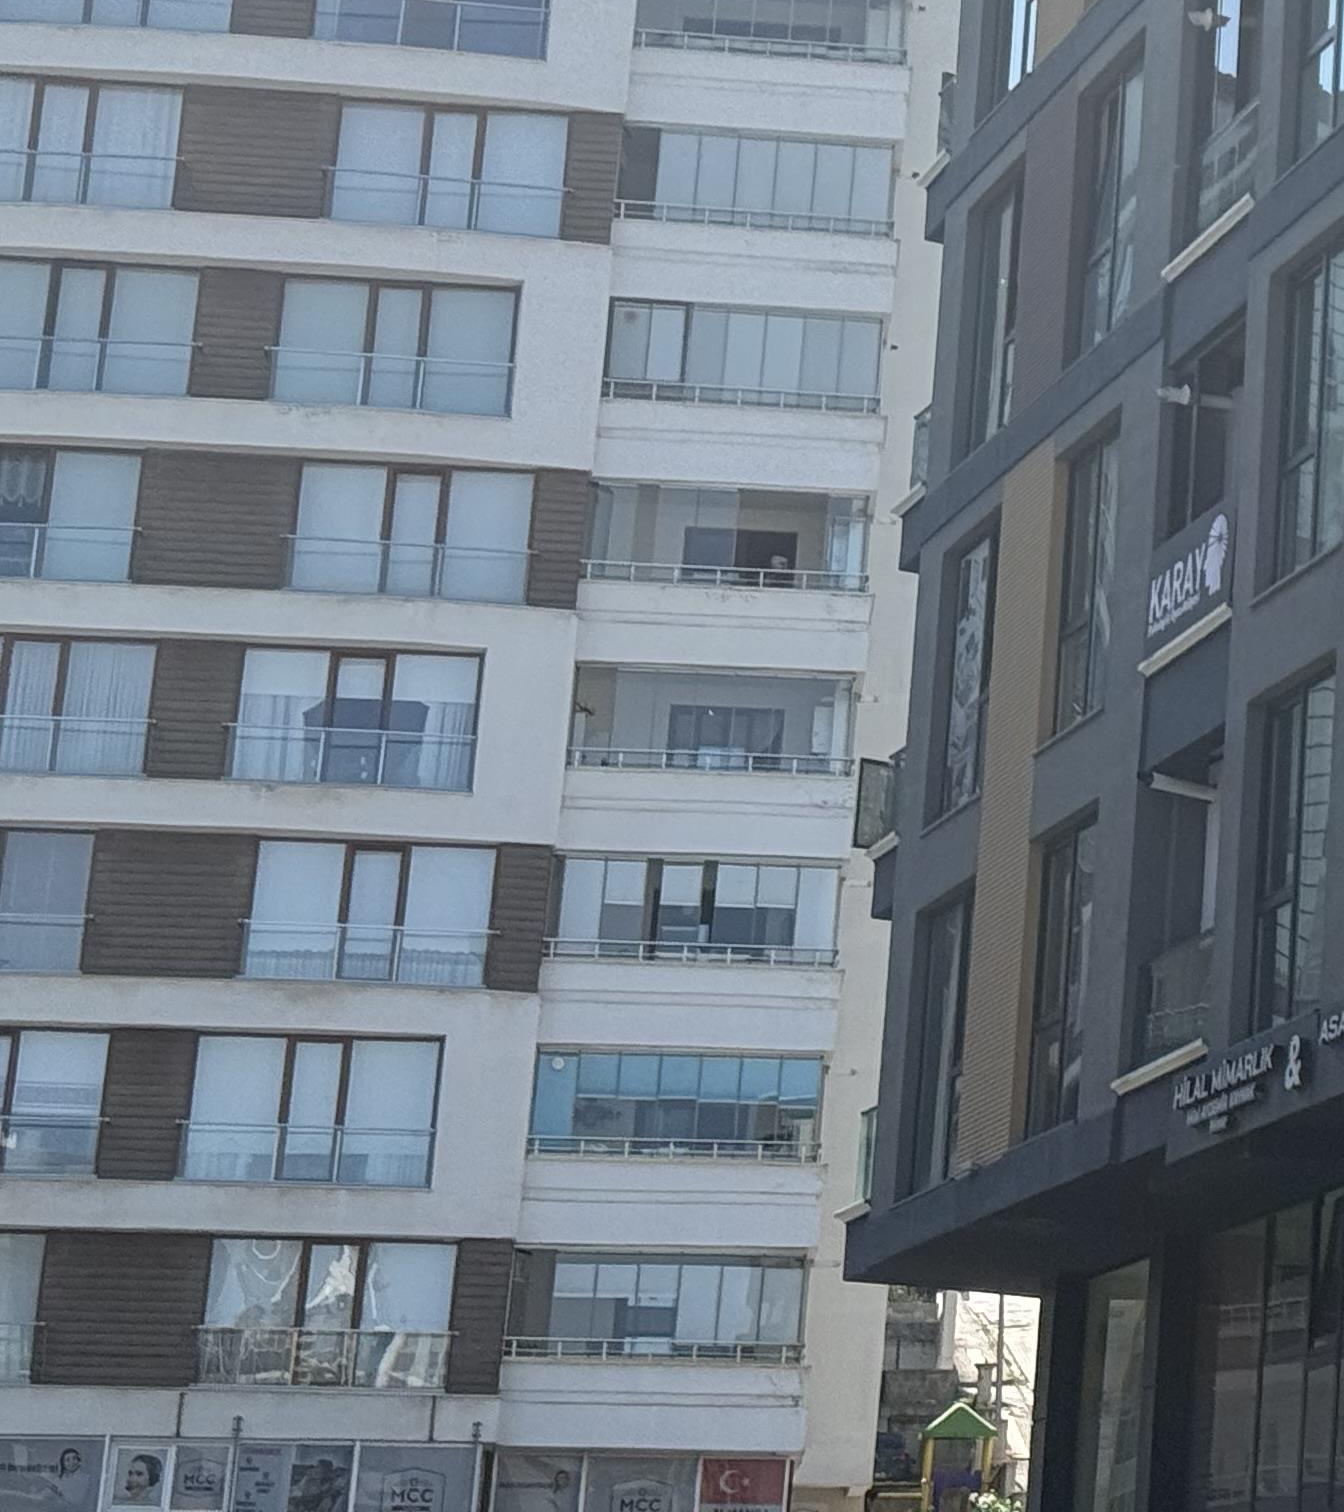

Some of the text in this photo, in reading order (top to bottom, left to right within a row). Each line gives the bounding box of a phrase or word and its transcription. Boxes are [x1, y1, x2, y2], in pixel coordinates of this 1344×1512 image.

[1148, 542, 1206, 624] KARAY
[391, 1488, 434, 1504] MCC
[620, 1498, 662, 1512] MCC
